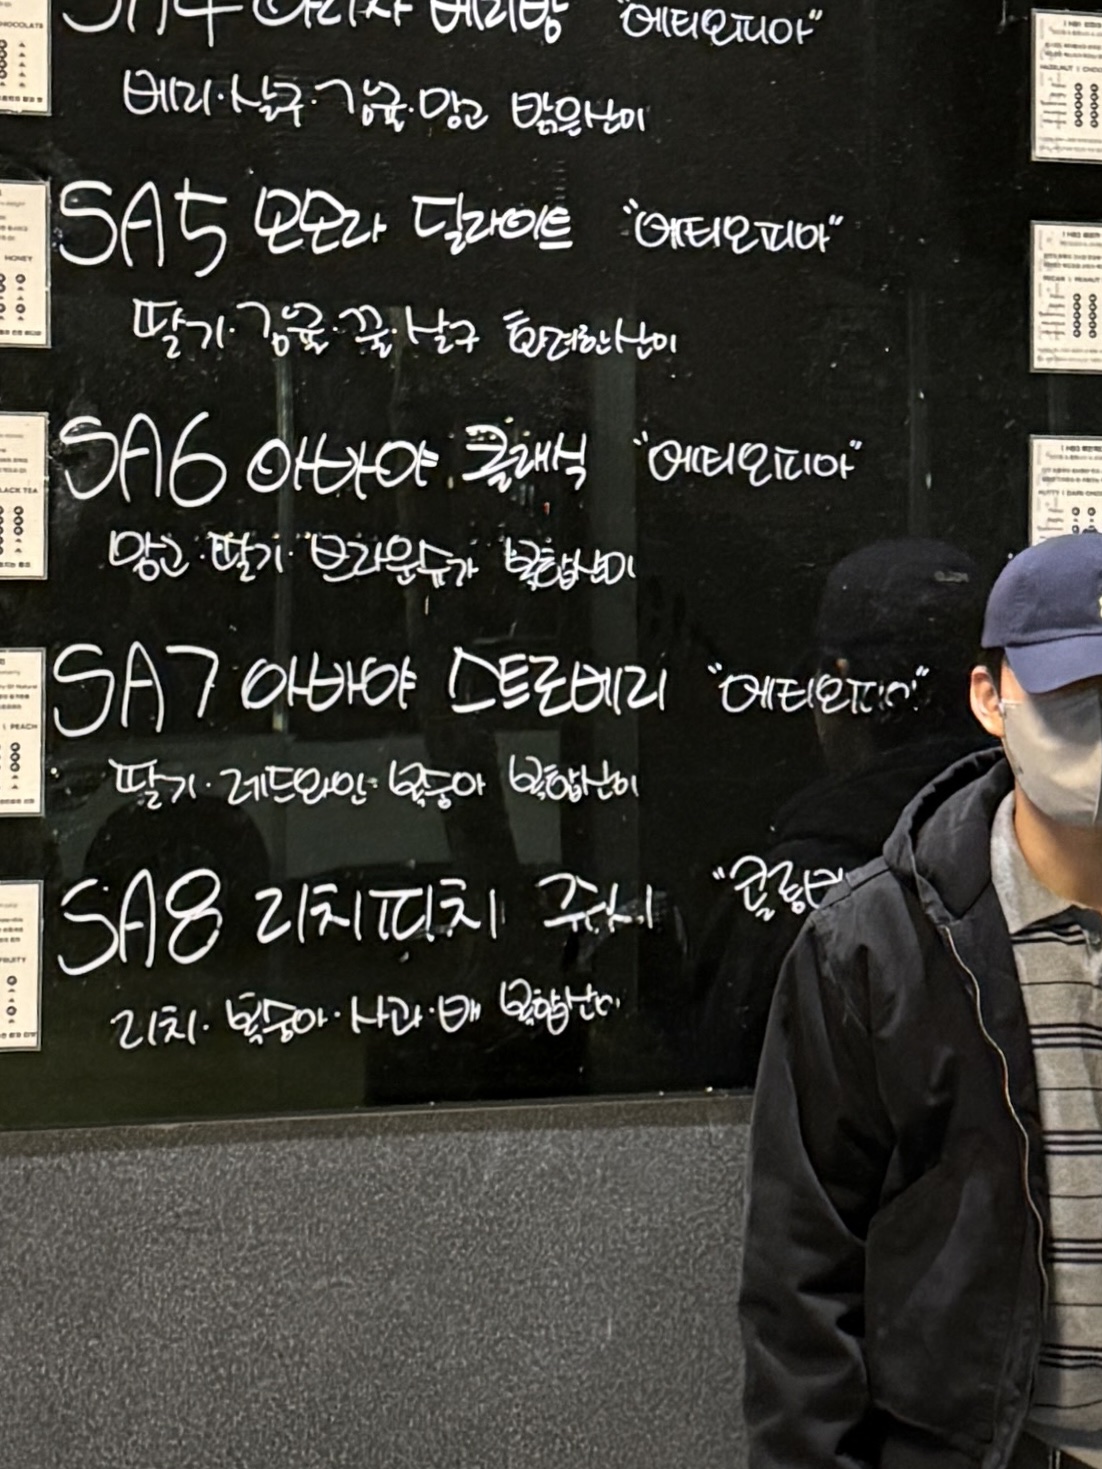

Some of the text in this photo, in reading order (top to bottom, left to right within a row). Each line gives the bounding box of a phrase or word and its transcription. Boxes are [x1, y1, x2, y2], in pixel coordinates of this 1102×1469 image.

[60, 178, 227, 277] SA5
[59, 412, 226, 507] SA6
[247, 433, 439, 500] 아바야
[53, 641, 218, 737] SA7
[241, 652, 417, 711] 아바야
[58, 869, 222, 975] SA8
